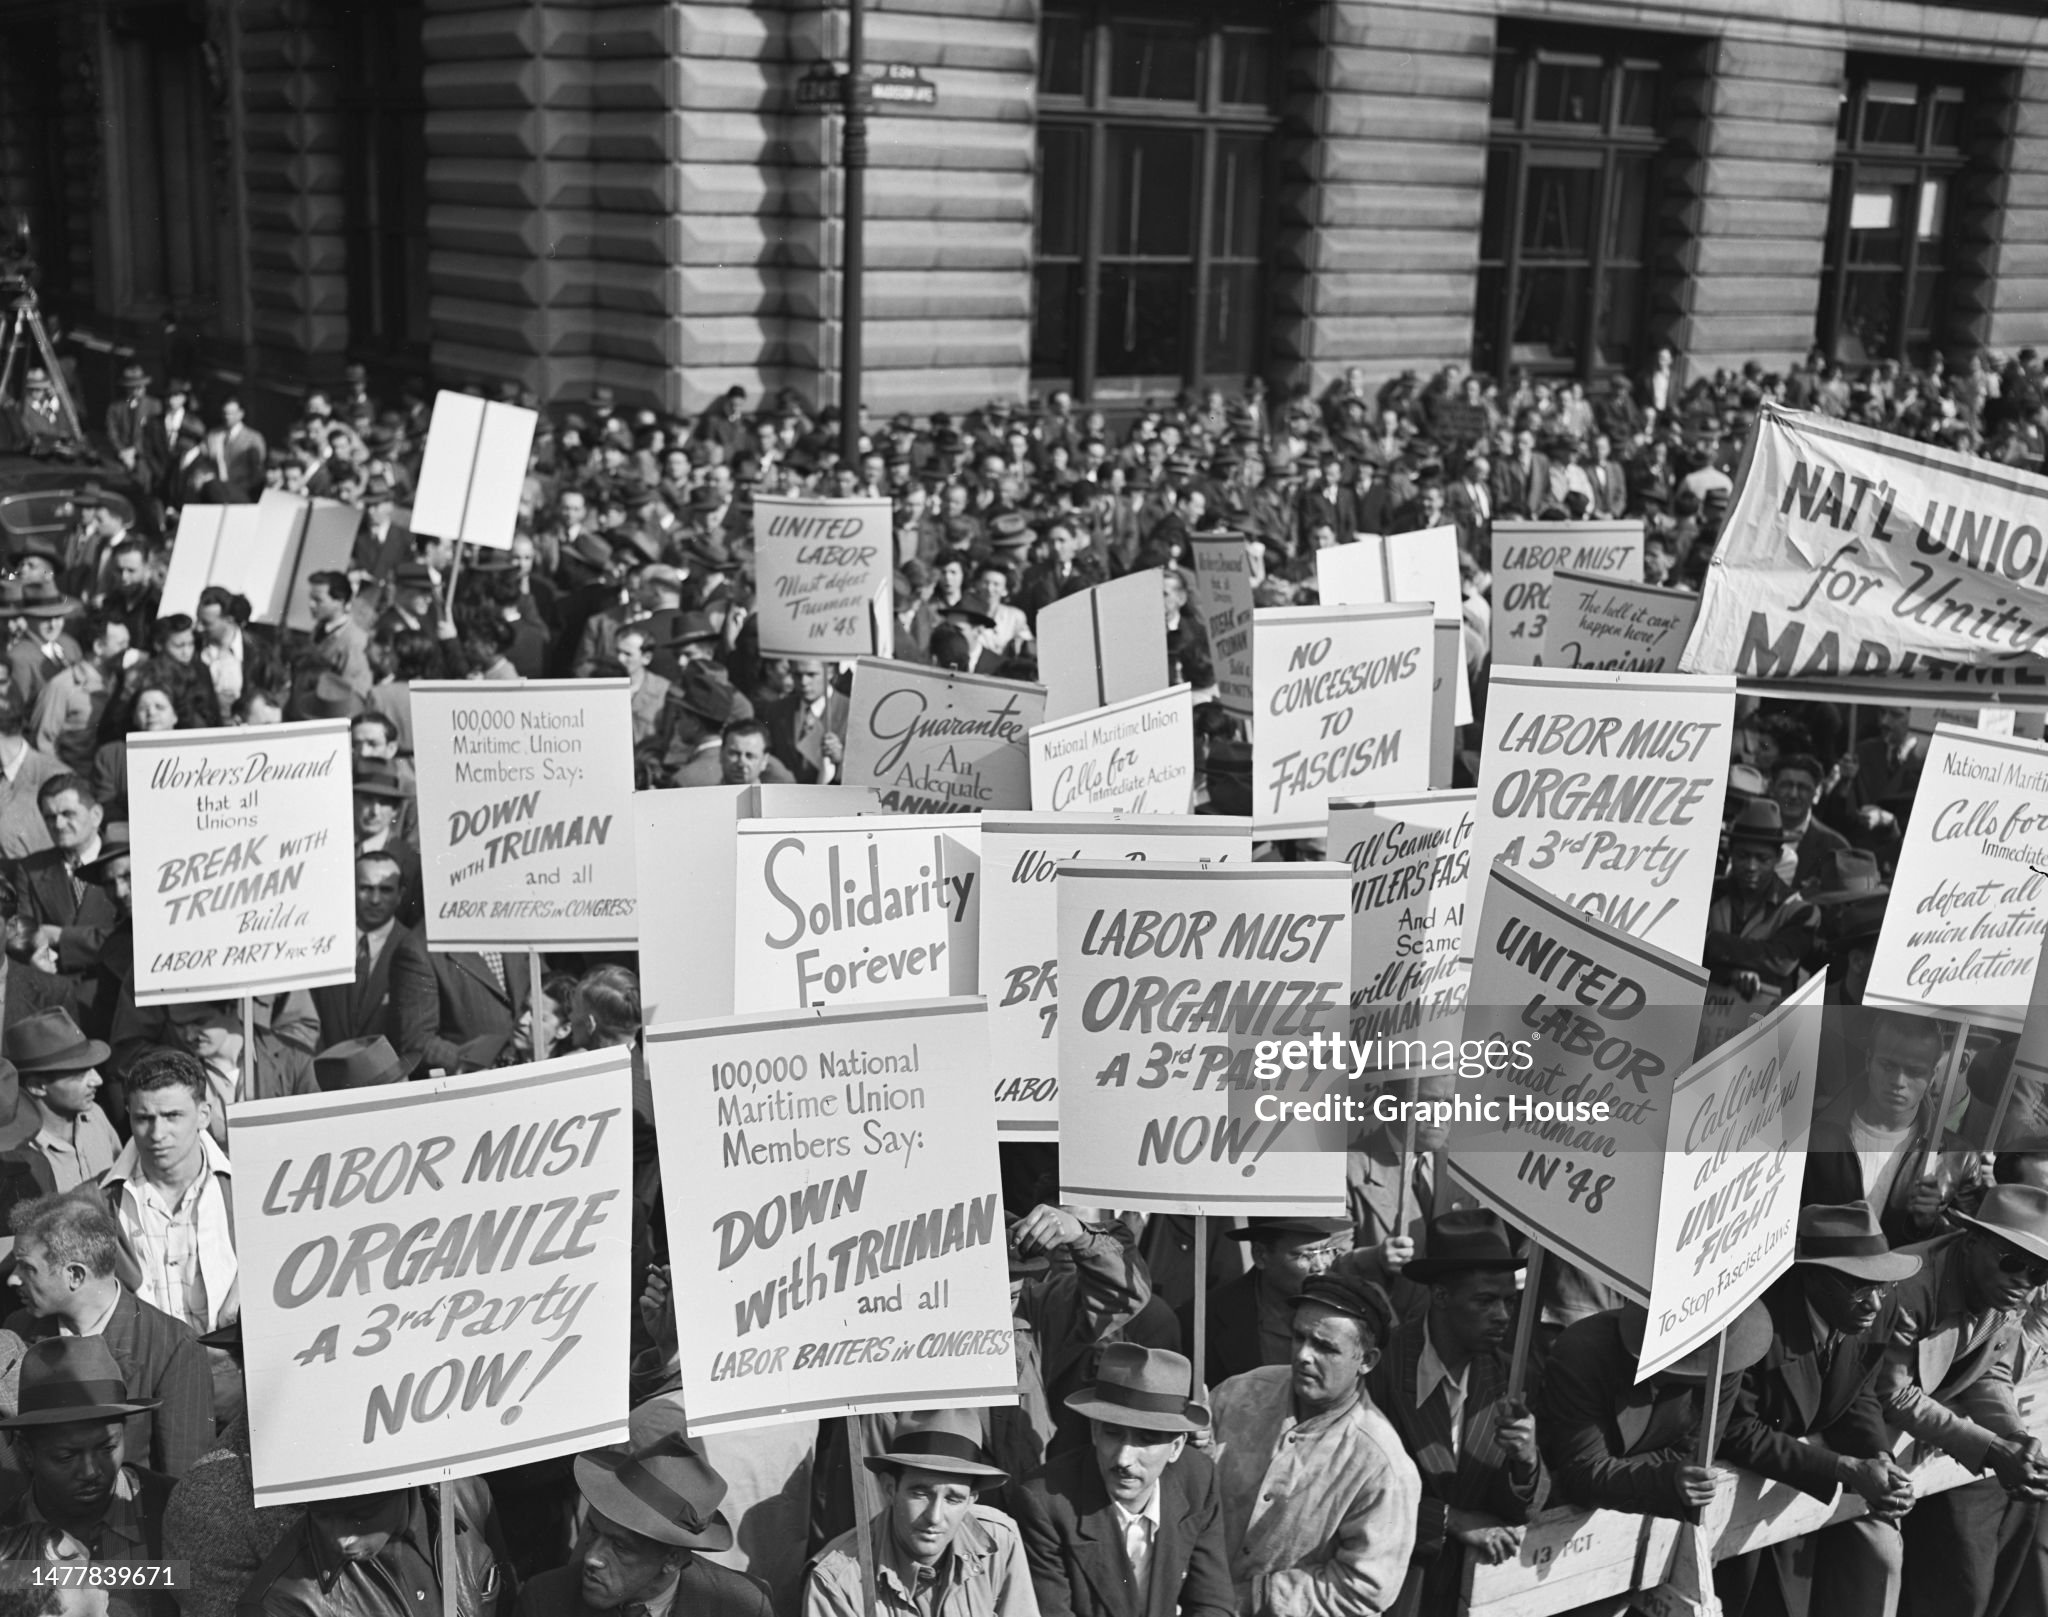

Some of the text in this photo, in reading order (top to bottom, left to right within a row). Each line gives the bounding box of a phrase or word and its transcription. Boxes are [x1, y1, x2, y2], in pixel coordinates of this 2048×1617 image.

[1780, 460, 1897, 542] NAT'L
[768, 515, 864, 540] UNITED
[796, 545, 877, 567] LABOR
[1502, 545, 1636, 571] LABOR MUST
[1787, 545, 1884, 612] for
[774, 571, 870, 598] Must defeat
[1579, 589, 1601, 614] The
[1602, 595, 1634, 620] hell
[1630, 607, 1648, 624] it
[809, 615, 860, 639] IN '48
[1579, 614, 1622, 638] happen
[1288, 637, 1332, 672] NO
[1270, 646, 1421, 717] CONCESSIONS
[452, 708, 585, 736] 100,000 National
[453, 733, 582, 755] Maritime Union
[869, 688, 1025, 777] Guarantee
[1044, 710, 1179, 762] National Maritime Union
[1320, 707, 1353, 740] TO
[1499, 712, 1721, 762] LABOR MUST
[150, 749, 338, 790] Workers Demand
[455, 757, 584, 788] Members Say:
[894, 762, 993, 801] Adequate
[936, 745, 973, 776] An
[1052, 758, 1103, 812] Calls
[1108, 747, 1139, 787] for
[1147, 764, 1186, 786] Action
[1269, 729, 1402, 814] FASCISM
[1942, 751, 2003, 784] National
[197, 789, 259, 812] that all
[197, 813, 258, 831] Unions
[448, 790, 541, 847] DOWN
[881, 790, 983, 814] ANNU
[1492, 768, 1714, 826] ORGANIZE
[1931, 798, 1998, 842] Calls
[157, 828, 328, 894] BREAK WITH
[450, 814, 613, 887] WITH TRUMAN
[1382, 822, 1451, 866] Seamen
[1496, 830, 1689, 888] A 3rd Party
[164, 861, 305, 926] TRUMAN
[525, 863, 593, 885] and all
[764, 834, 975, 950] Solidarity
[1352, 860, 1429, 914] ITLER'S
[1916, 873, 2044, 918] defeat all
[238, 901, 309, 935] Build a
[439, 900, 488, 920] LABOR
[490, 900, 551, 919] BAITERS
[565, 898, 637, 918] CONGRESS
[1398, 907, 1437, 931] And
[1563, 893, 1680, 938] OW!
[1907, 920, 1968, 948] union
[150, 949, 218, 974] LABOR
[222, 941, 287, 968] PARTY
[311, 934, 337, 957] '48
[1081, 909, 1345, 963] LABOR MUST
[796, 941, 947, 1008] Forever
[1351, 954, 1459, 1009] will fight
[1496, 916, 1647, 1021] UNITED
[1906, 948, 2034, 998] legislation
[1082, 976, 1343, 1036] ORGANIZE
[1350, 996, 1427, 1045] RUMAN
[712, 1043, 919, 1094] 100,000 National
[1095, 1053, 1130, 1088] A
[1136, 1042, 1197, 1090] 3rd
[1521, 993, 1665, 1095] LABOR
[718, 1083, 925, 1127] Maritime Union
[994, 1077, 1058, 1102] LABO
[1685, 1057, 1776, 1155] Calling
[722, 1119, 925, 1168] Members Say:
[1138, 1111, 1295, 1178] NOW!
[1693, 1070, 1801, 1191] all unions
[262, 1108, 621, 1216] LABOR MUST
[1518, 1150, 1616, 1214] IN '48
[712, 1170, 867, 1271] DOWN
[1676, 1151, 1769, 1252] UNITE
[1693, 1174, 1786, 1276] FIGHT
[272, 1189, 621, 1309] ORGANIZE
[829, 1194, 997, 1292] TRUMAN
[857, 1279, 949, 1314] and all
[1659, 1307, 1676, 1336] To
[1679, 1287, 1715, 1323] Stop
[1717, 1247, 1762, 1296] Fascist
[293, 1273, 599, 1366] A 3rd Party
[710, 1346, 789, 1382] LABOR
[792, 1337, 895, 1370] BAITERS
[916, 1329, 1013, 1359] CONGRESS
[362, 1335, 582, 1444] NOW!
[1563, 1533, 1595, 1557] PCT
